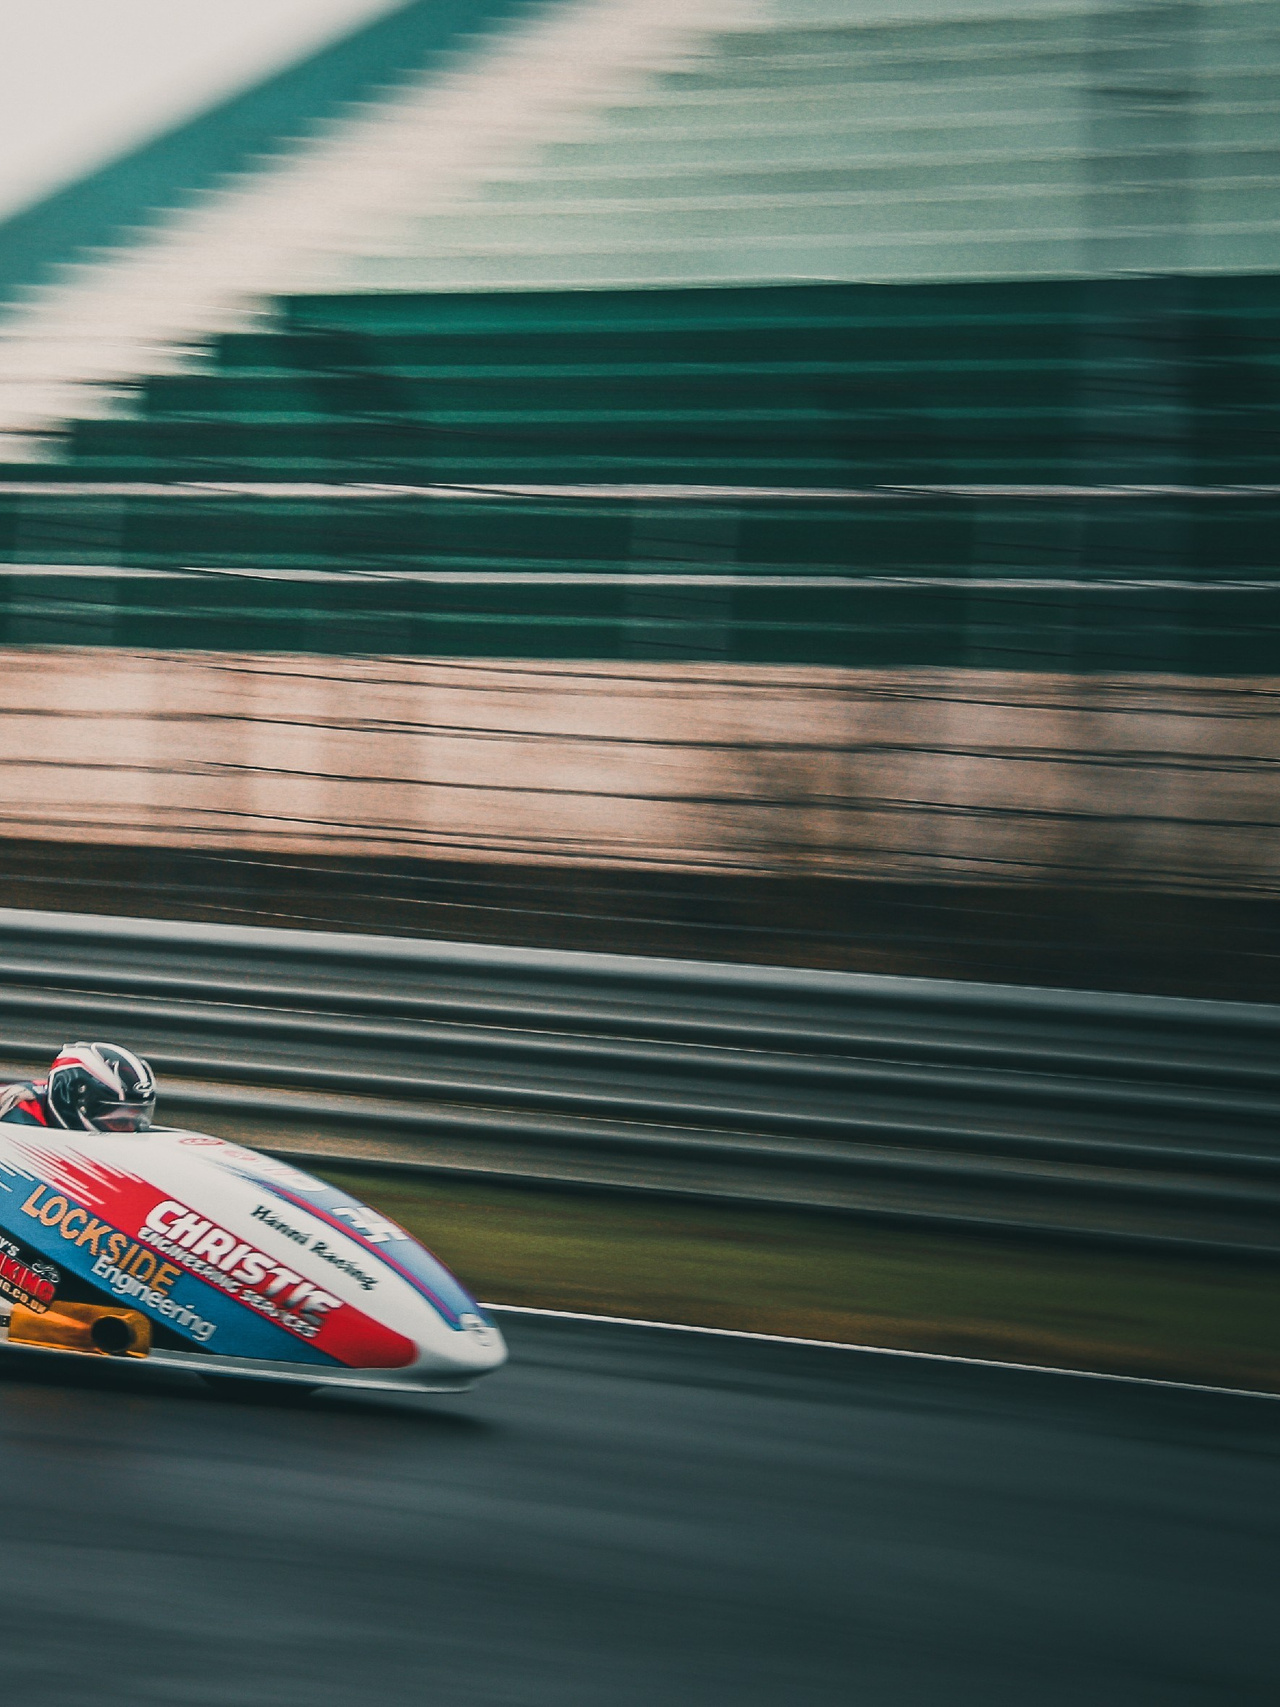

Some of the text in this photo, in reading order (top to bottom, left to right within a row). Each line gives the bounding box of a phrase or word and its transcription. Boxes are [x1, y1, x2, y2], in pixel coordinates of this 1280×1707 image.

[20, 1184, 182, 1296] LOCKSIDE
[144, 1200, 346, 1326] CHRISTIE
[91, 1254, 218, 1342] Engineering
